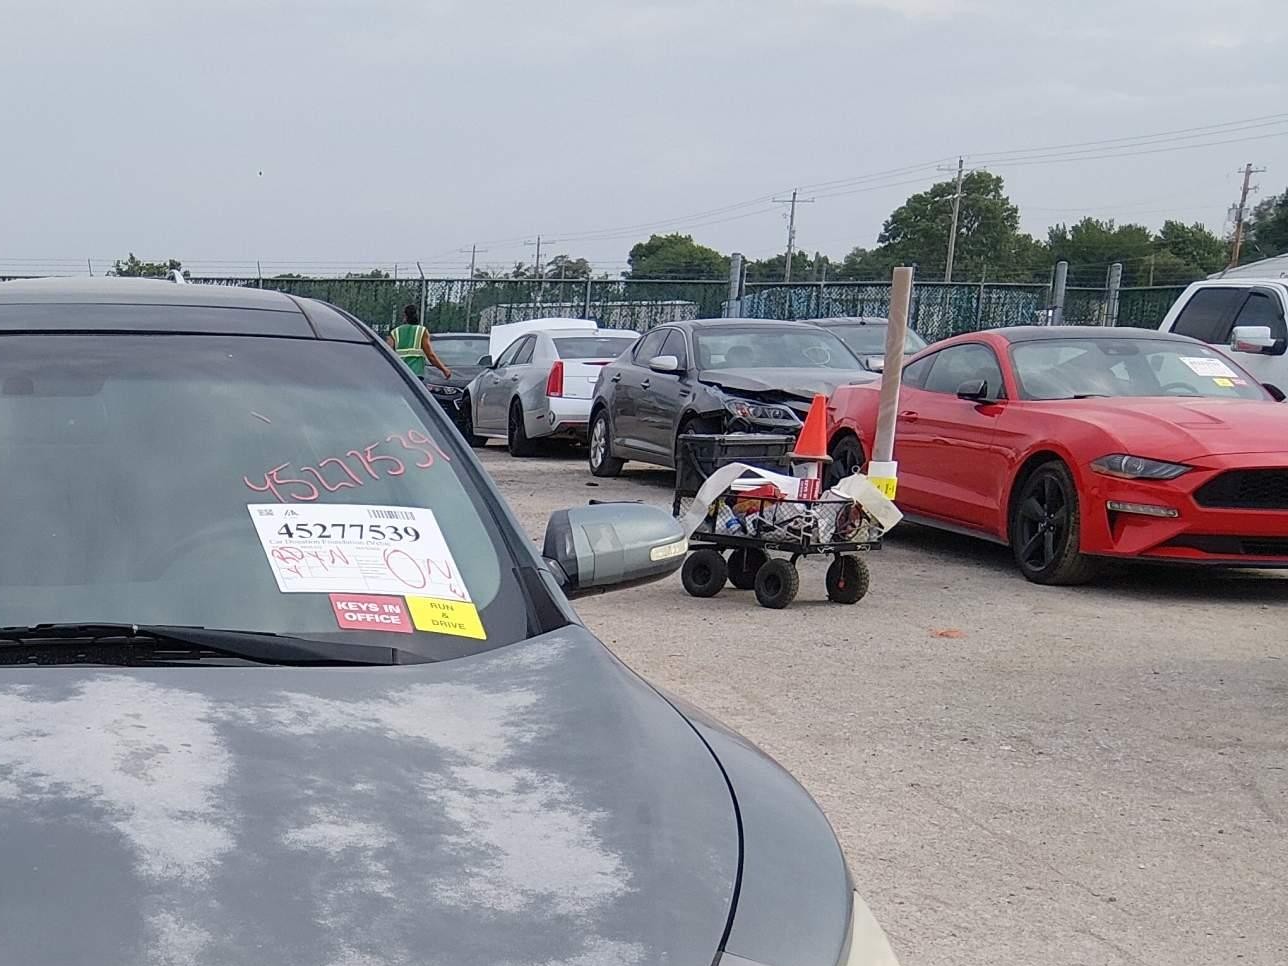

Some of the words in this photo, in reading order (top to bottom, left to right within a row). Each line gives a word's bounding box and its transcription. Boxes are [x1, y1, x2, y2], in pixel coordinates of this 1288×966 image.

[277, 522, 420, 542] 45277539
[336, 601, 379, 612] KEYS
[383, 603, 401, 614] IN
[430, 602, 455, 612] RUN
[344, 612, 402, 625] OFFICE
[431, 619, 467, 631] DRIVE
